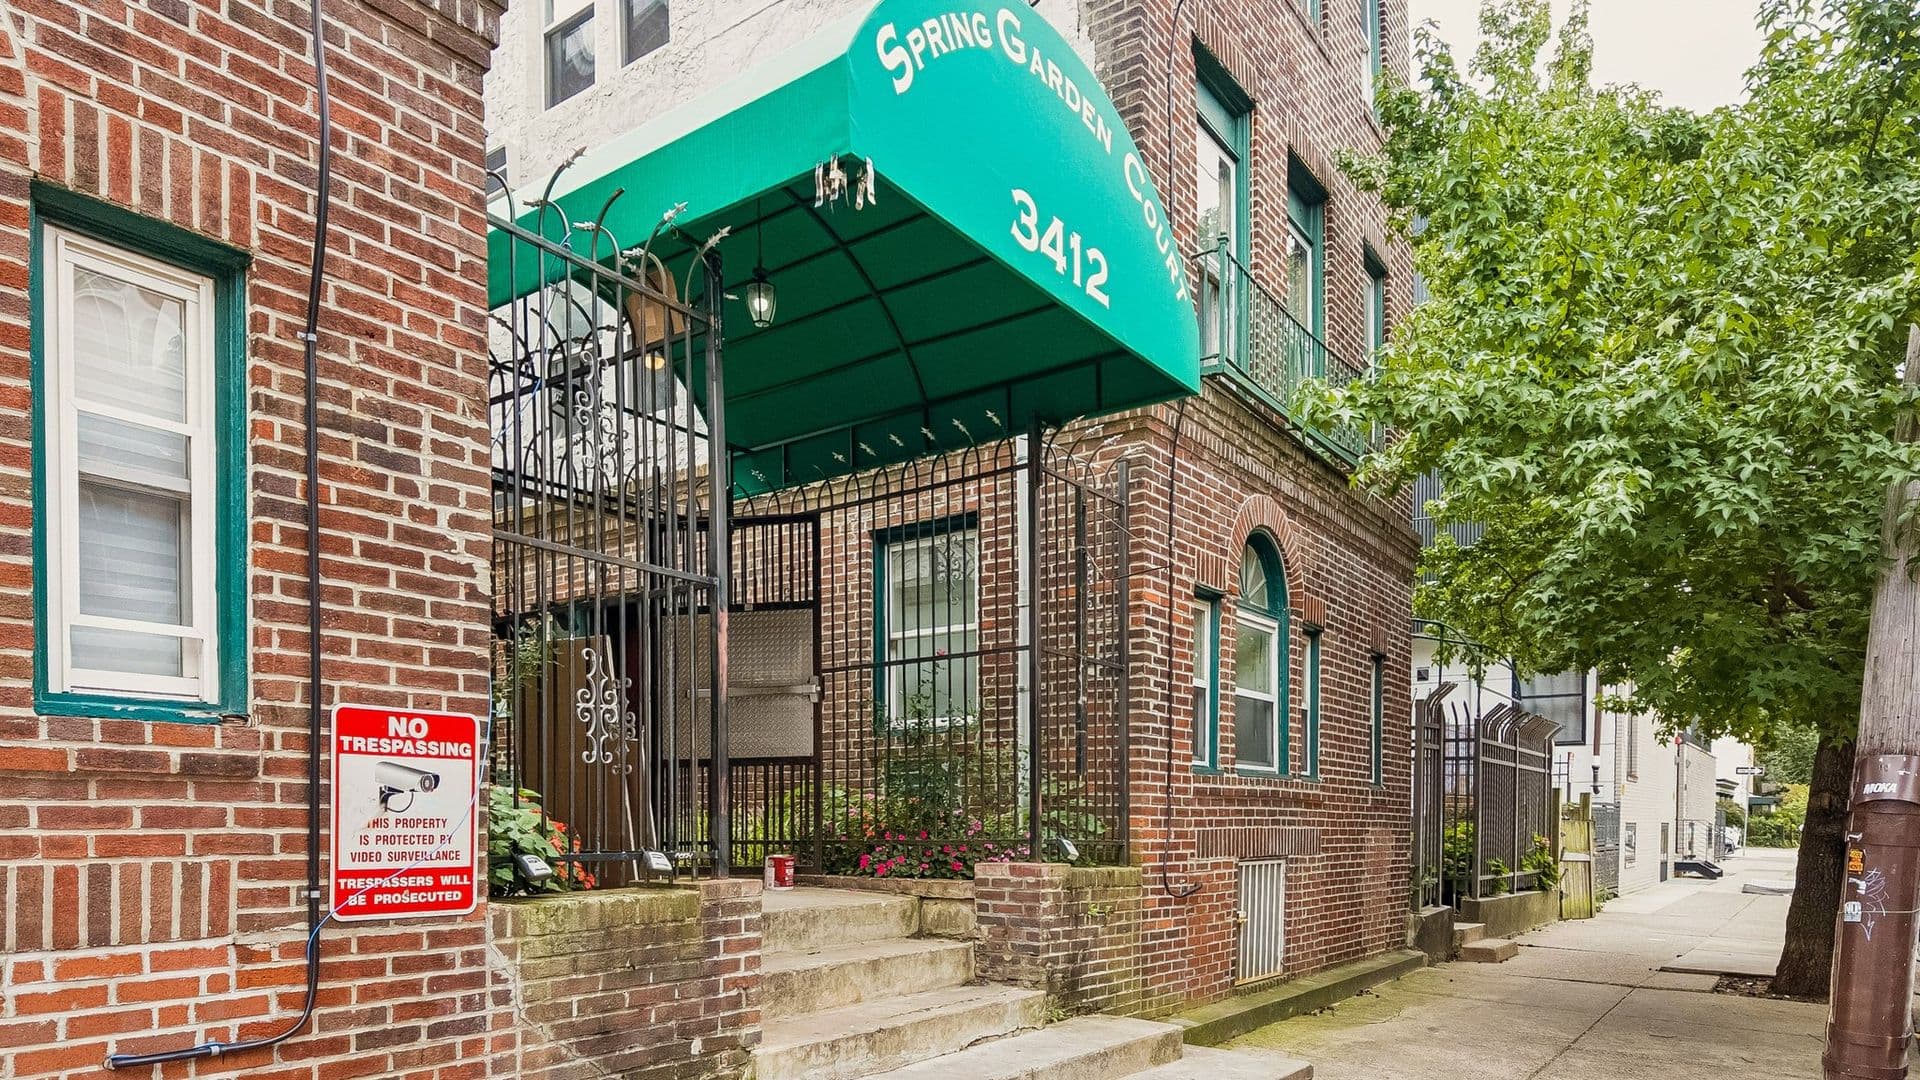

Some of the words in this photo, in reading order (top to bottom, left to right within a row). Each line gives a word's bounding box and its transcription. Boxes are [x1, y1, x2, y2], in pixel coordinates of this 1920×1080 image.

[1010, 188, 1111, 310] 3412
[388, 716, 429, 739] NO
[339, 736, 472, 757] TRESPASSING
[395, 818, 448, 829] PROPERTY
[359, 834, 370, 846] IS
[375, 834, 435, 846] PROTECTED
[350, 851, 382, 862] VIDEO
[387, 850, 461, 862] SURVEILLANCE
[338, 875, 434, 890] TRESPASSERS
[440, 874, 471, 886] WILL
[348, 894, 367, 906] BE
[374, 890, 462, 904] PROSECUTED
